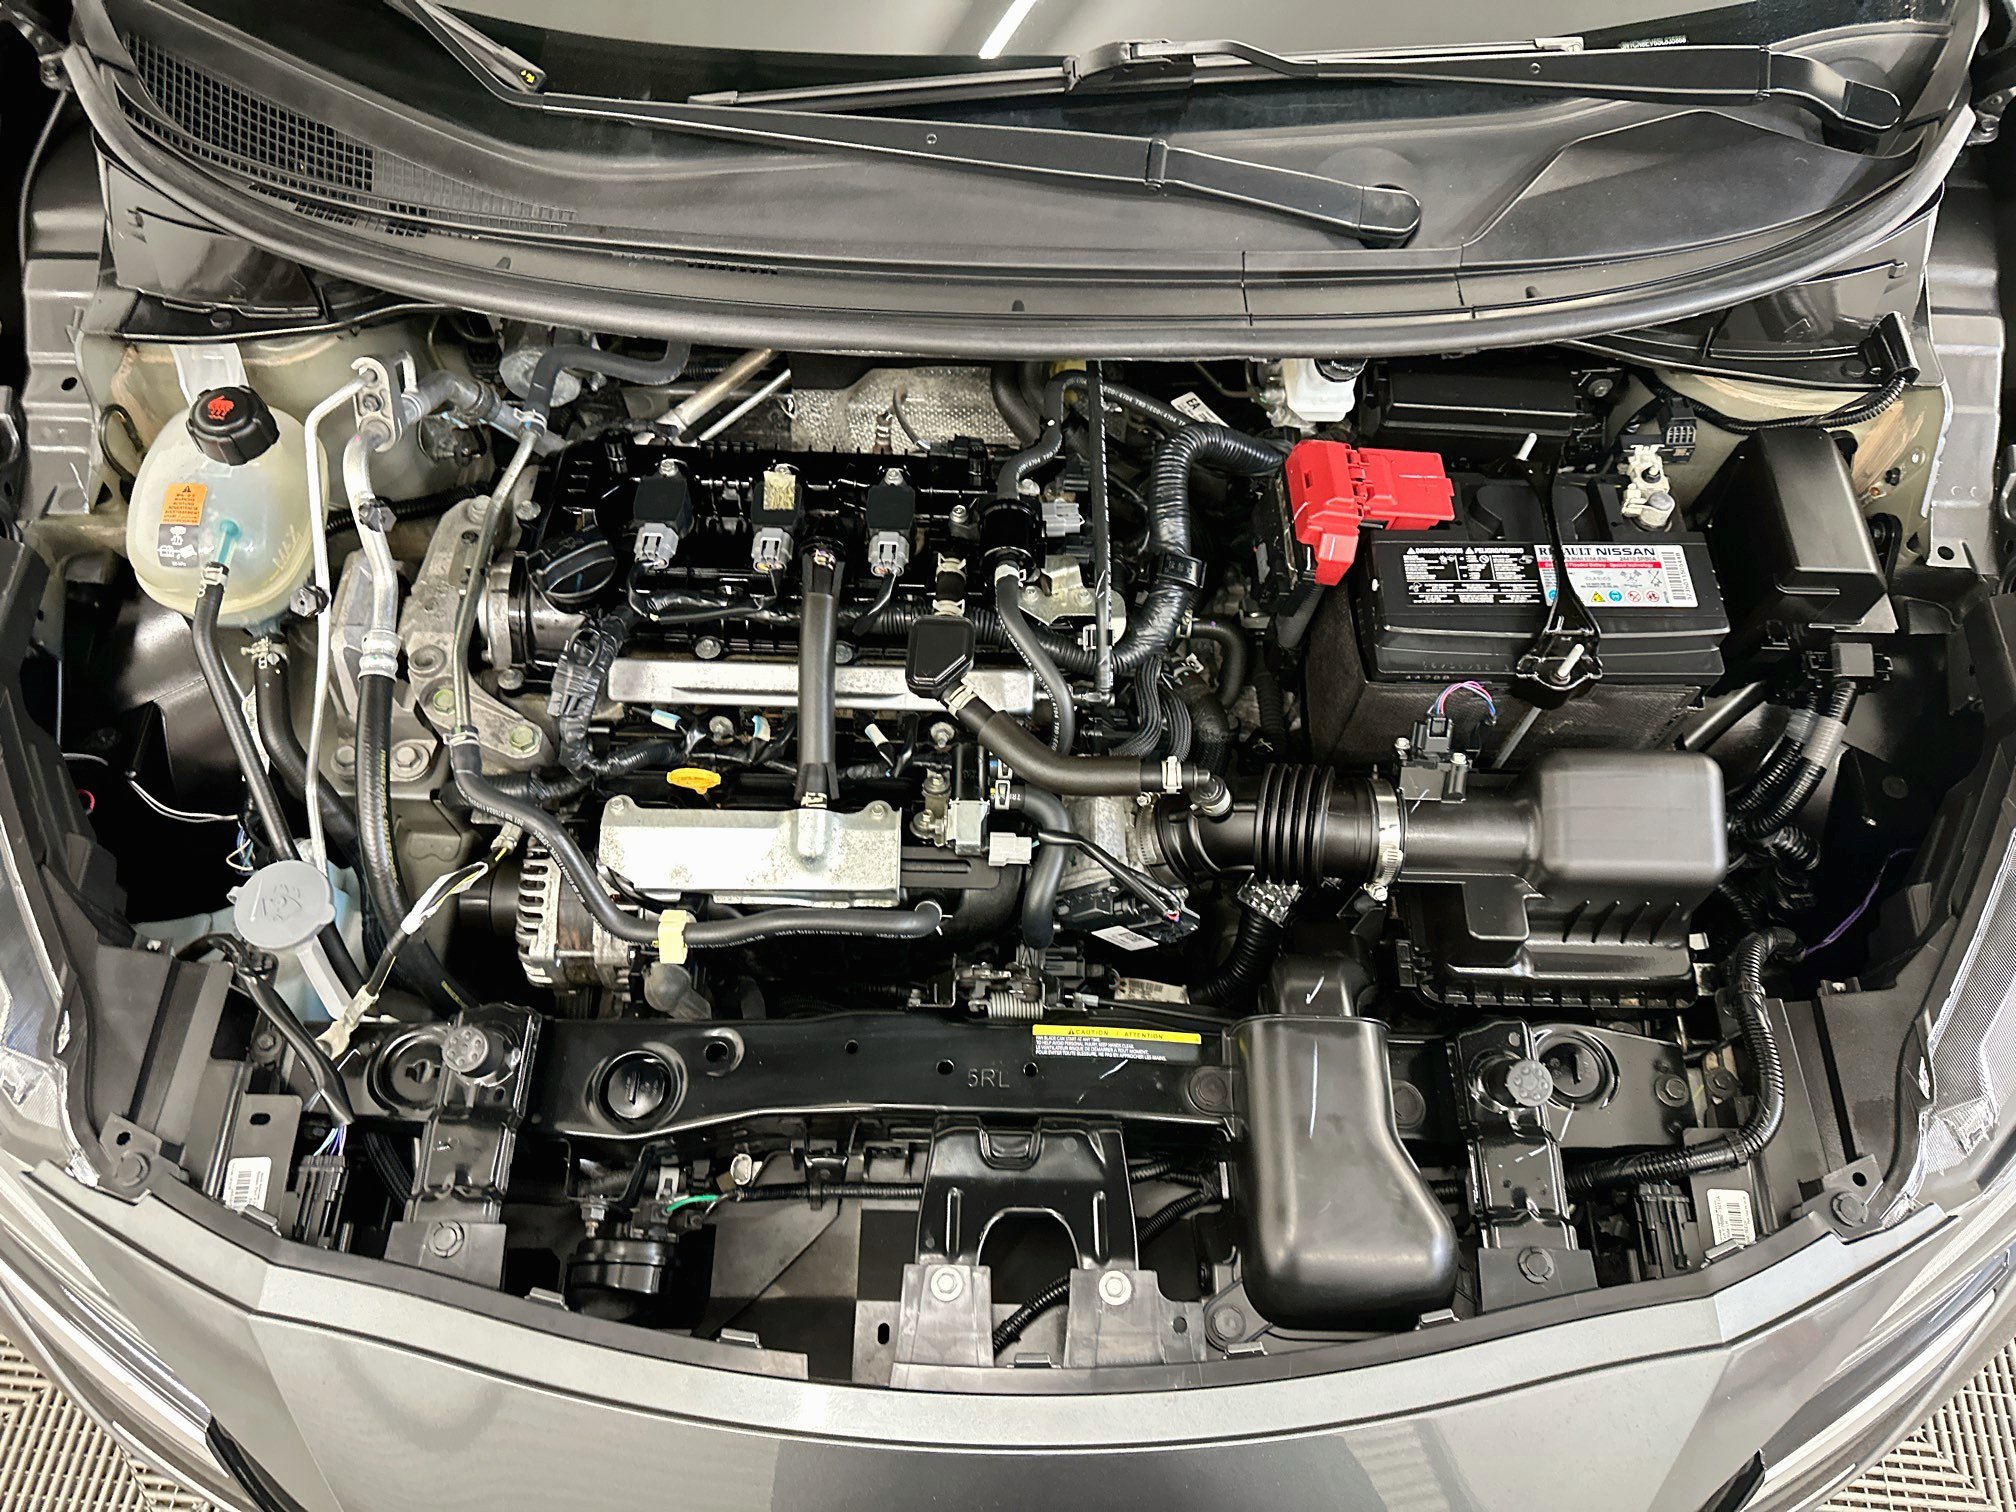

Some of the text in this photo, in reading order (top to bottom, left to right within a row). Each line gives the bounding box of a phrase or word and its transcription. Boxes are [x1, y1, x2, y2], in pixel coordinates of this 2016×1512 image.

[1186, 398, 1200, 410] EA
[1538, 547, 1656, 556] RAULT NISSAN
[1124, 1031, 1163, 1040] ATTENTION
[967, 1068, 1010, 1088] 5RL
